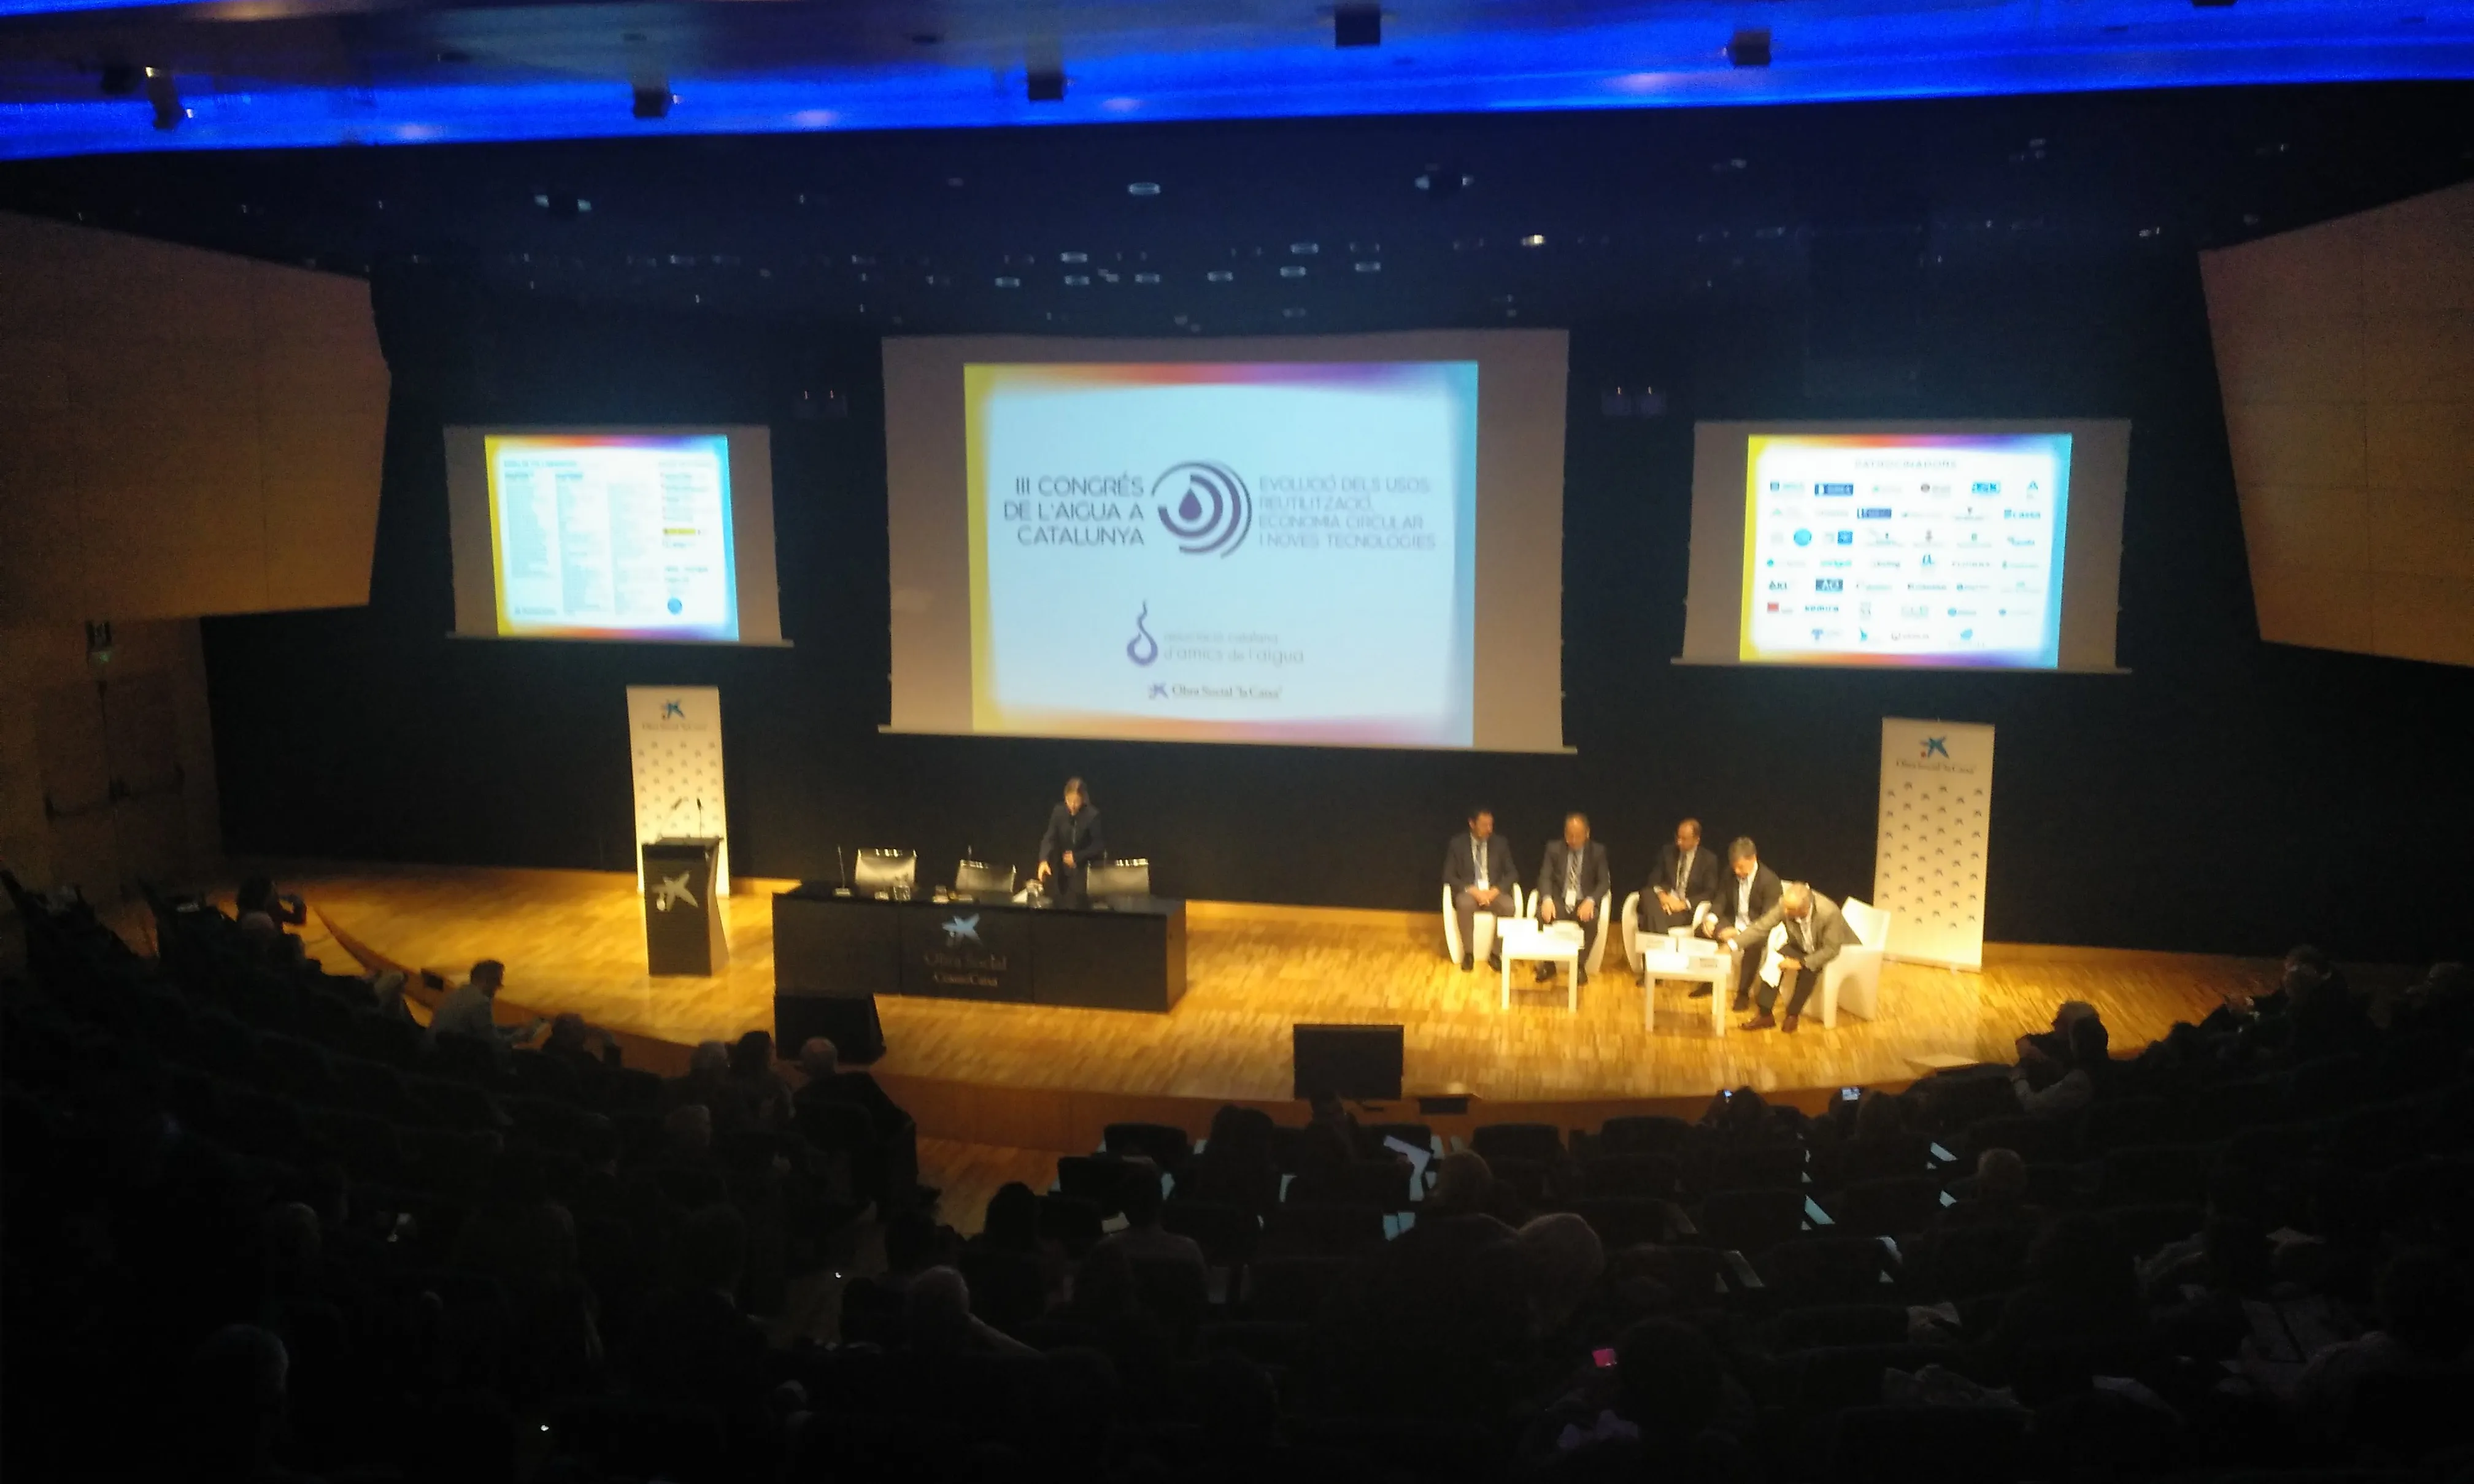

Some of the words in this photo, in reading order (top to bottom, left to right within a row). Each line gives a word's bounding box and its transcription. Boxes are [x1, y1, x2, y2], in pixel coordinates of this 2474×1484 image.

[1016, 475, 1030, 496] III
[1038, 469, 1144, 498] CONGRÉS
[1259, 472, 1336, 492] EVOLUCIÓ
[1341, 475, 1381, 492] DELS
[1004, 499, 1032, 521] DE
[1038, 500, 1122, 521] L'AIGUA
[1129, 501, 1145, 521] A
[1259, 514, 1341, 529] ECONOMIA
[1346, 515, 1424, 530] CIRCULAR
[1017, 524, 1145, 547] CATALUNYA
[1267, 533, 1319, 548] NOVES
[1328, 533, 1436, 549] TECNOLOGIES
